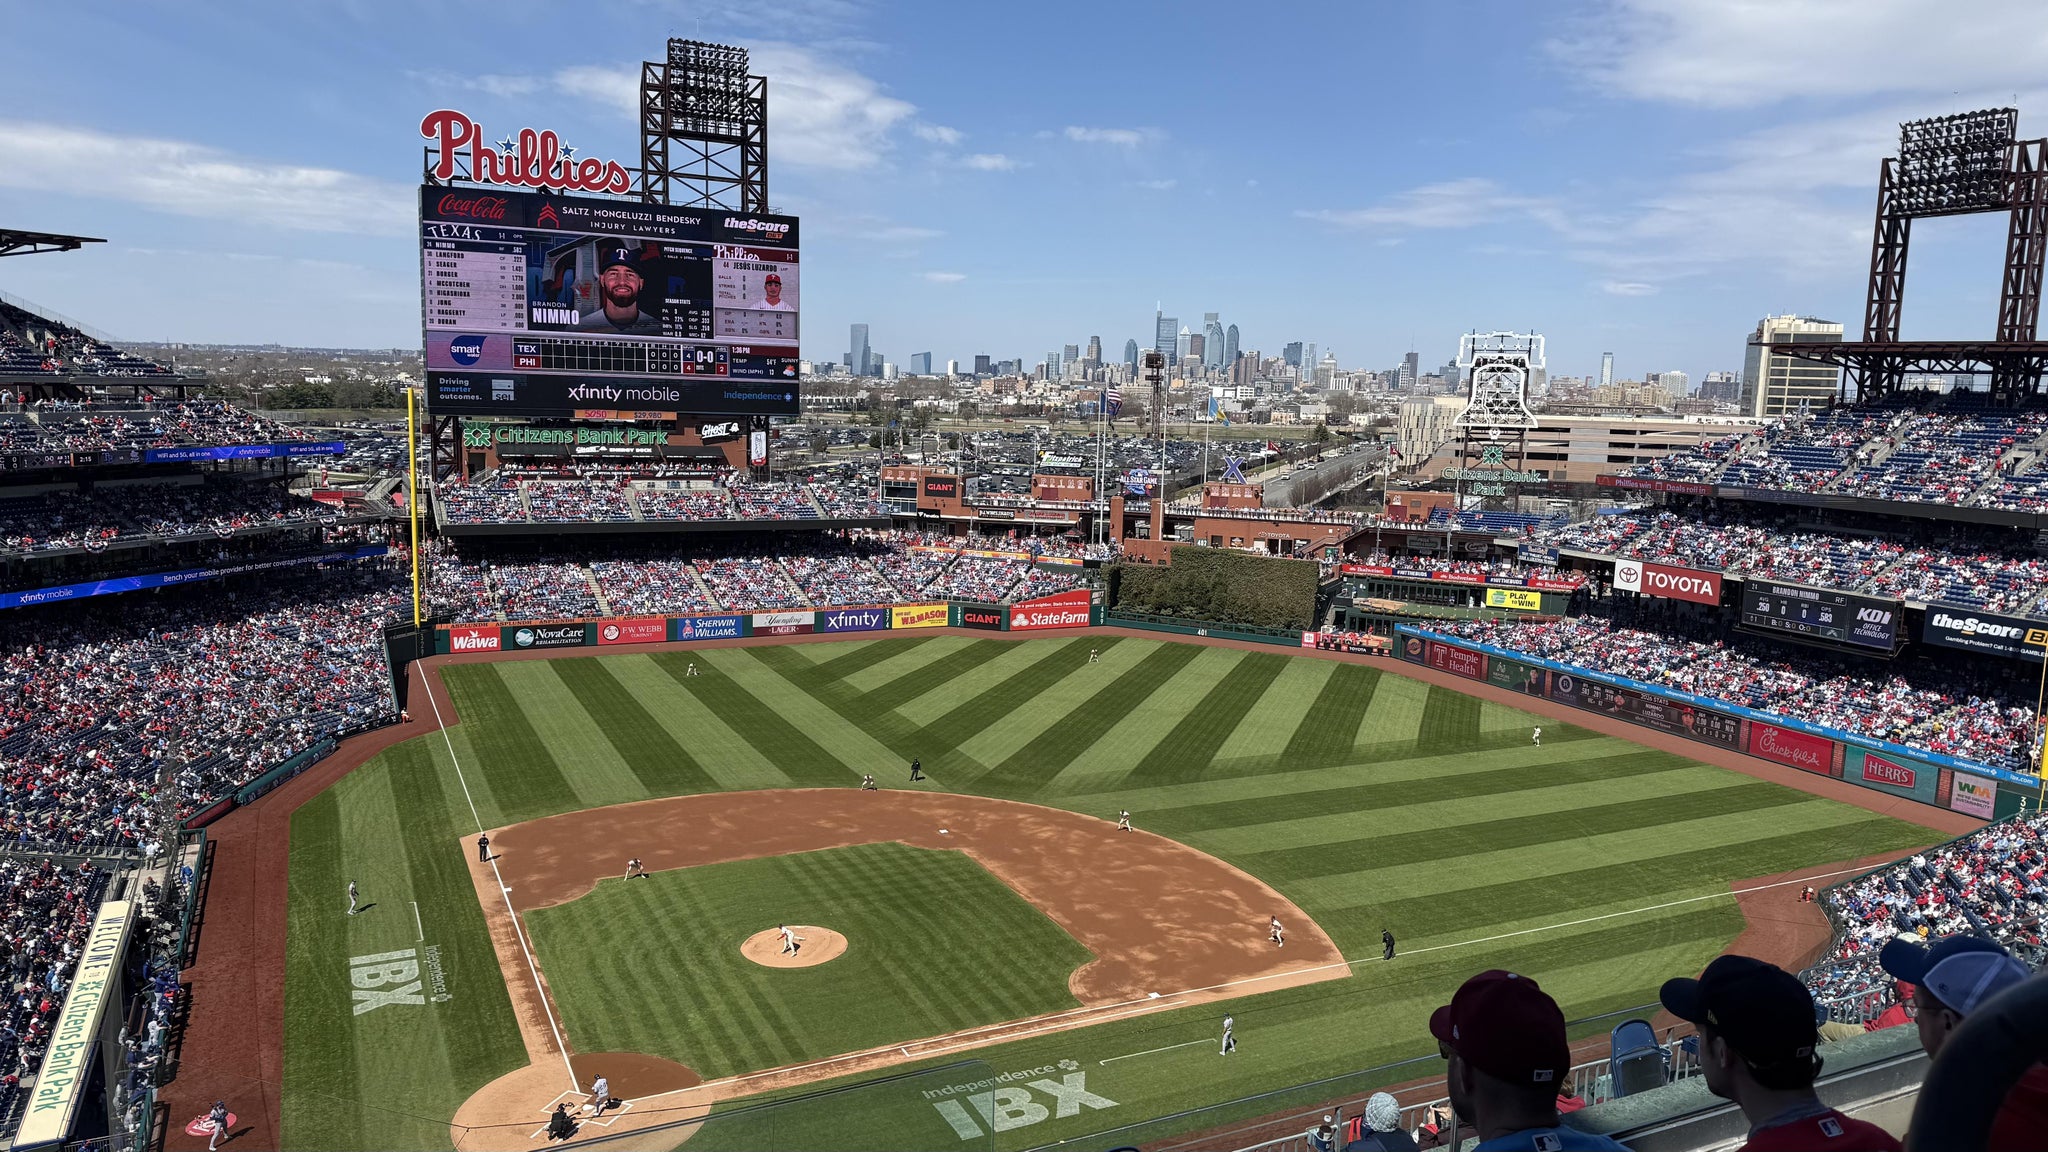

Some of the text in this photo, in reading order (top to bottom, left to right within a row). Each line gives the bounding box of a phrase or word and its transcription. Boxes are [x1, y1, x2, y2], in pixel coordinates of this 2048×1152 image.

[421, 109, 631, 194] Phillies
[437, 193, 509, 220] Coca-Cola
[562, 206, 701, 226] SALTZ MONGELUZZI BENDESKY
[427, 224, 482, 240] TEXAS
[590, 221, 676, 235] INJURY LAWYERS
[724, 217, 789, 233] theScore
[713, 244, 760, 261] Phillies
[532, 308, 580, 325] NIMMO
[450, 344, 480, 354] smart
[517, 344, 536, 353] TEX
[696, 350, 714, 363] 0-0
[439, 377, 469, 386] Driving
[568, 384, 680, 402] xfinity mobile
[724, 391, 782, 400] Independence
[495, 426, 668, 445] Citizens Bank Park
[702, 422, 732, 439] GHOST
[1042, 452, 1082, 462] Fitzpatrick
[1222, 456, 1248, 484] X
[1442, 467, 1540, 482] Citizens Bank
[1473, 483, 1505, 496] Park
[1615, 479, 1635, 488] Phillies
[164, 574, 182, 582] Bench
[184, 572, 197, 580] your
[199, 569, 219, 578] mobile
[220, 566, 244, 576] provider
[273, 558, 296, 568] coverage
[308, 554, 324, 563] bigger
[1646, 572, 1713, 596] TOYOTA
[20, 589, 73, 603] xfinity mobile
[1772, 586, 1798, 597] BRANDON
[1799, 590, 1819, 600] NIMMO
[964, 613, 1001, 625] GIANT
[1756, 602, 1832, 622] .250 0 0 .583
[1857, 607, 1892, 624] KDI
[696, 619, 736, 628] SHERWIN
[765, 616, 803, 625] Yuengling
[828, 612, 880, 629] xfinity
[1932, 614, 2024, 639] theScore
[535, 627, 584, 639] NovaCare
[695, 628, 737, 637] WILLIAMS.
[1854, 628, 1890, 640] TECHNOLOGY
[453, 636, 498, 649] Wawa
[1945, 636, 1968, 644] Gambling
[1969, 640, 1993, 648] Problem?
[1449, 648, 1479, 664] Temple
[1449, 660, 1476, 675] Health
[1590, 672, 1611, 681] Independence
[1655, 697, 1670, 706] STATS
[1665, 690, 1690, 700] Independence
[1642, 709, 1665, 720] LUZARDO
[1645, 704, 1663, 712] NIMMO
[1750, 711, 1778, 722] Independence
[1805, 724, 1823, 732] ibx.com
[1760, 728, 1820, 765] Chick-fil-A
[1846, 734, 1877, 746] Independence
[1907, 749, 1928, 759] ibx.com
[1868, 760, 1909, 783] HERR'S
[1953, 760, 1990, 774] Independence
[2010, 774, 2033, 785] ibx.com
[1958, 782, 1991, 798] WM
[1956, 798, 1990, 809] SUSTAINABILITY
[83, 915, 126, 970] WELCOME
[425, 944, 446, 993] Independence
[349, 948, 425, 1016] IBX
[62, 992, 100, 1044] Citizens
[46, 1042, 85, 1077] Bank
[921, 1064, 1056, 1100] Independence
[33, 1077, 74, 1113] Park
[932, 1071, 1121, 1141] IBX
